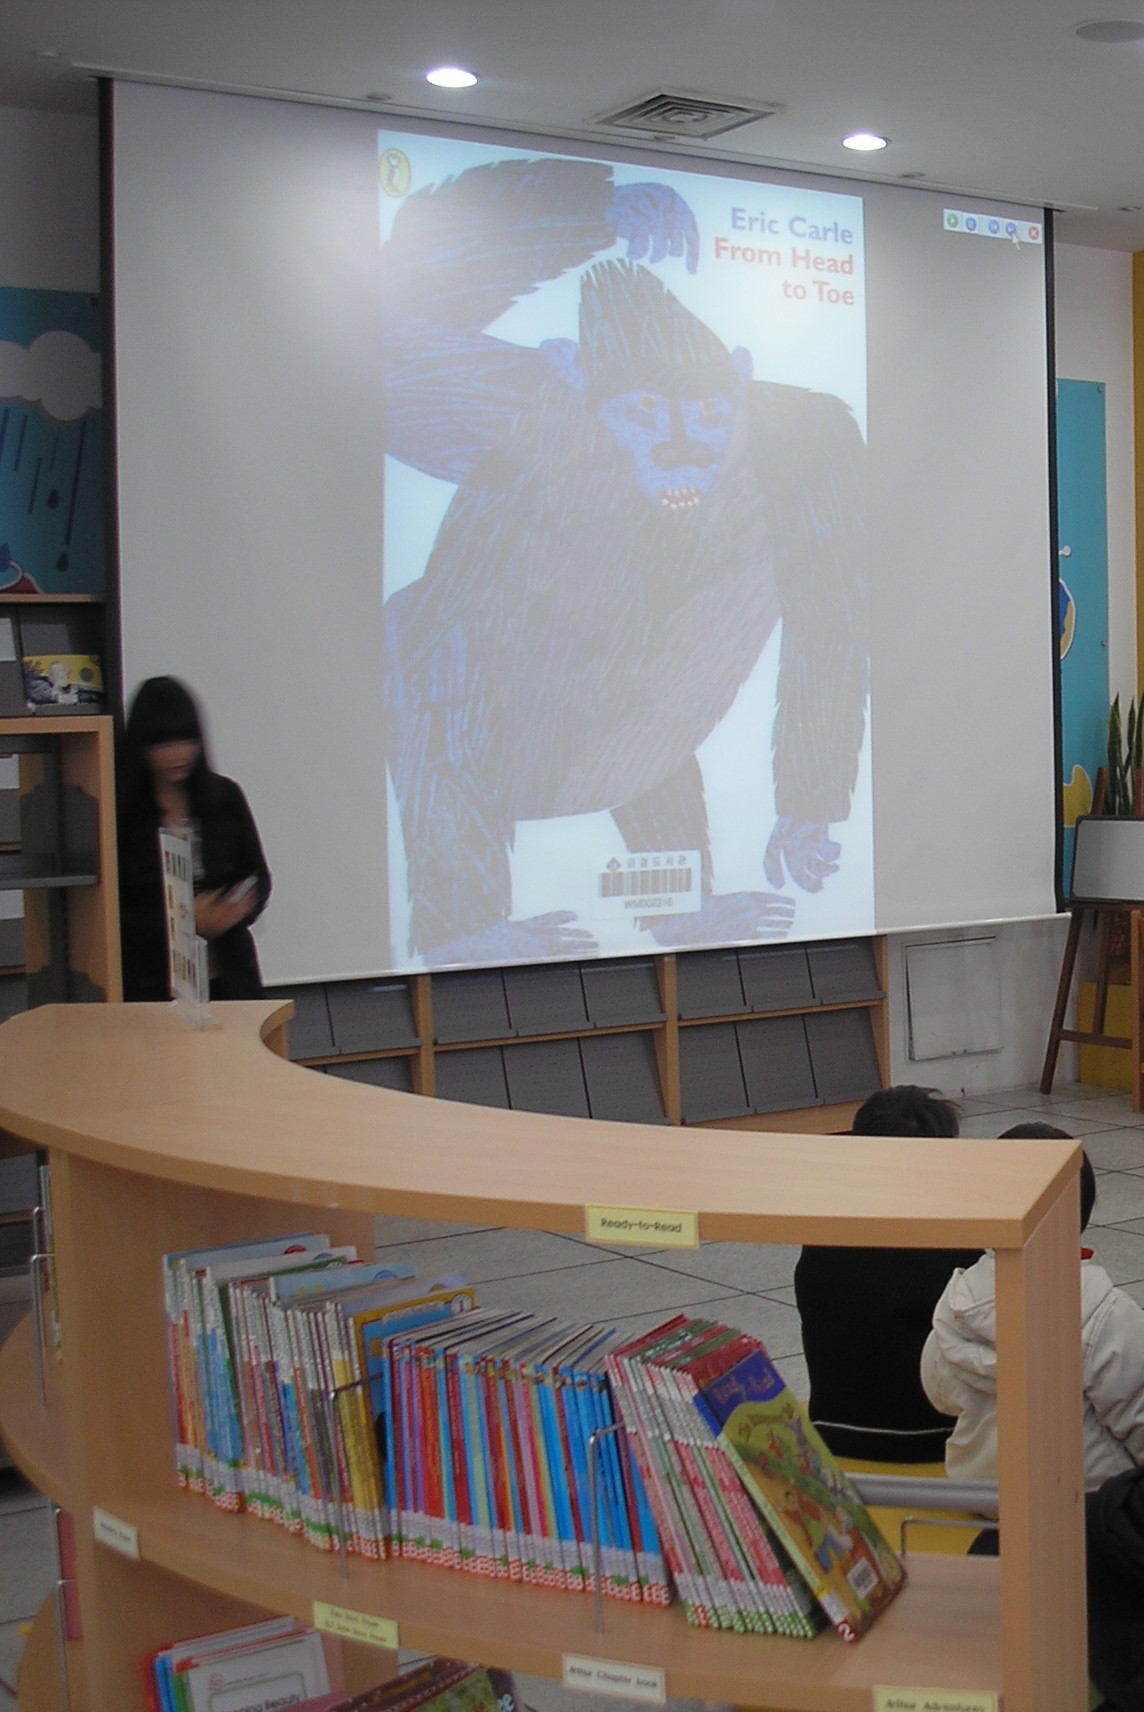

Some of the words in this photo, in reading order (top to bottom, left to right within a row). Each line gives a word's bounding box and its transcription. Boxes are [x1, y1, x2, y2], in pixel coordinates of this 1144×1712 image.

[731, 207, 779, 235] Eric
[788, 216, 853, 245] Carle
[714, 237, 782, 267] From
[791, 244, 854, 276] Head
[782, 280, 807, 300] to
[813, 281, 855, 306] Toe
[601, 1217, 682, 1233] Ready-to-Read
